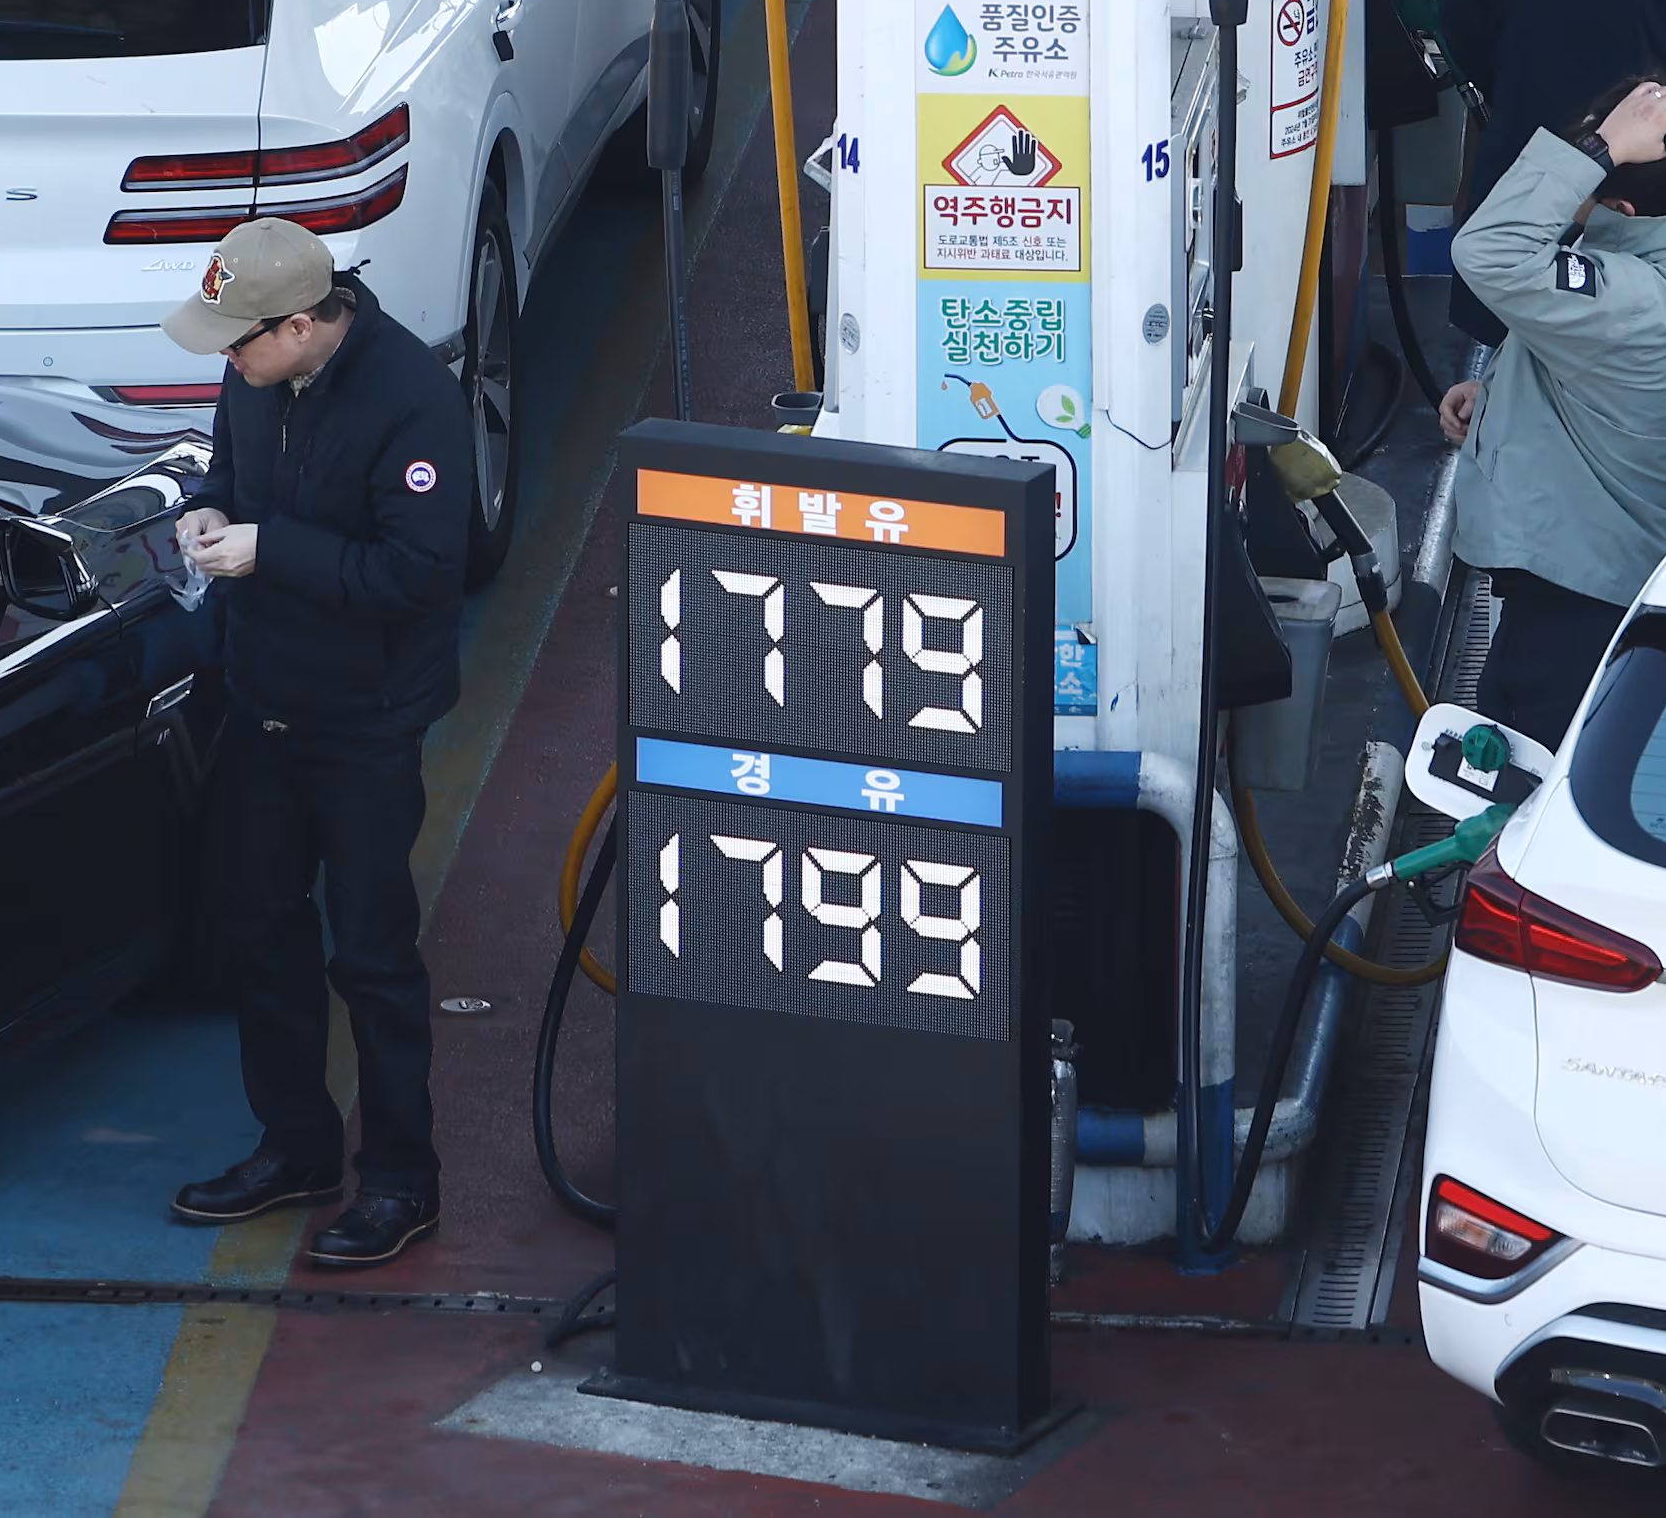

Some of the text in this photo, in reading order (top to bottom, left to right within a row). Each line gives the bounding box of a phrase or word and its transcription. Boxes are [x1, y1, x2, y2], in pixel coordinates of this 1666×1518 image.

[979, 3, 1081, 34] 품질인증
[992, 36, 1069, 63] 주유소
[1000, 69, 1023, 79] Petro
[836, 133, 860, 174] 14
[1141, 139, 1170, 182] 15
[933, 195, 1072, 229] 역주행금지
[937, 248, 1069, 262] 지시위반 과태료 대상입니다.
[938, 235, 1067, 248] 도로교통법 제5조 신호 또는
[941, 297, 1063, 332] 탄소중립
[941, 331, 1063, 363] 실천하기
[731, 483, 910, 545] 휘발유
[660, 568, 983, 734] 1779
[659, 832, 982, 999] 1799
